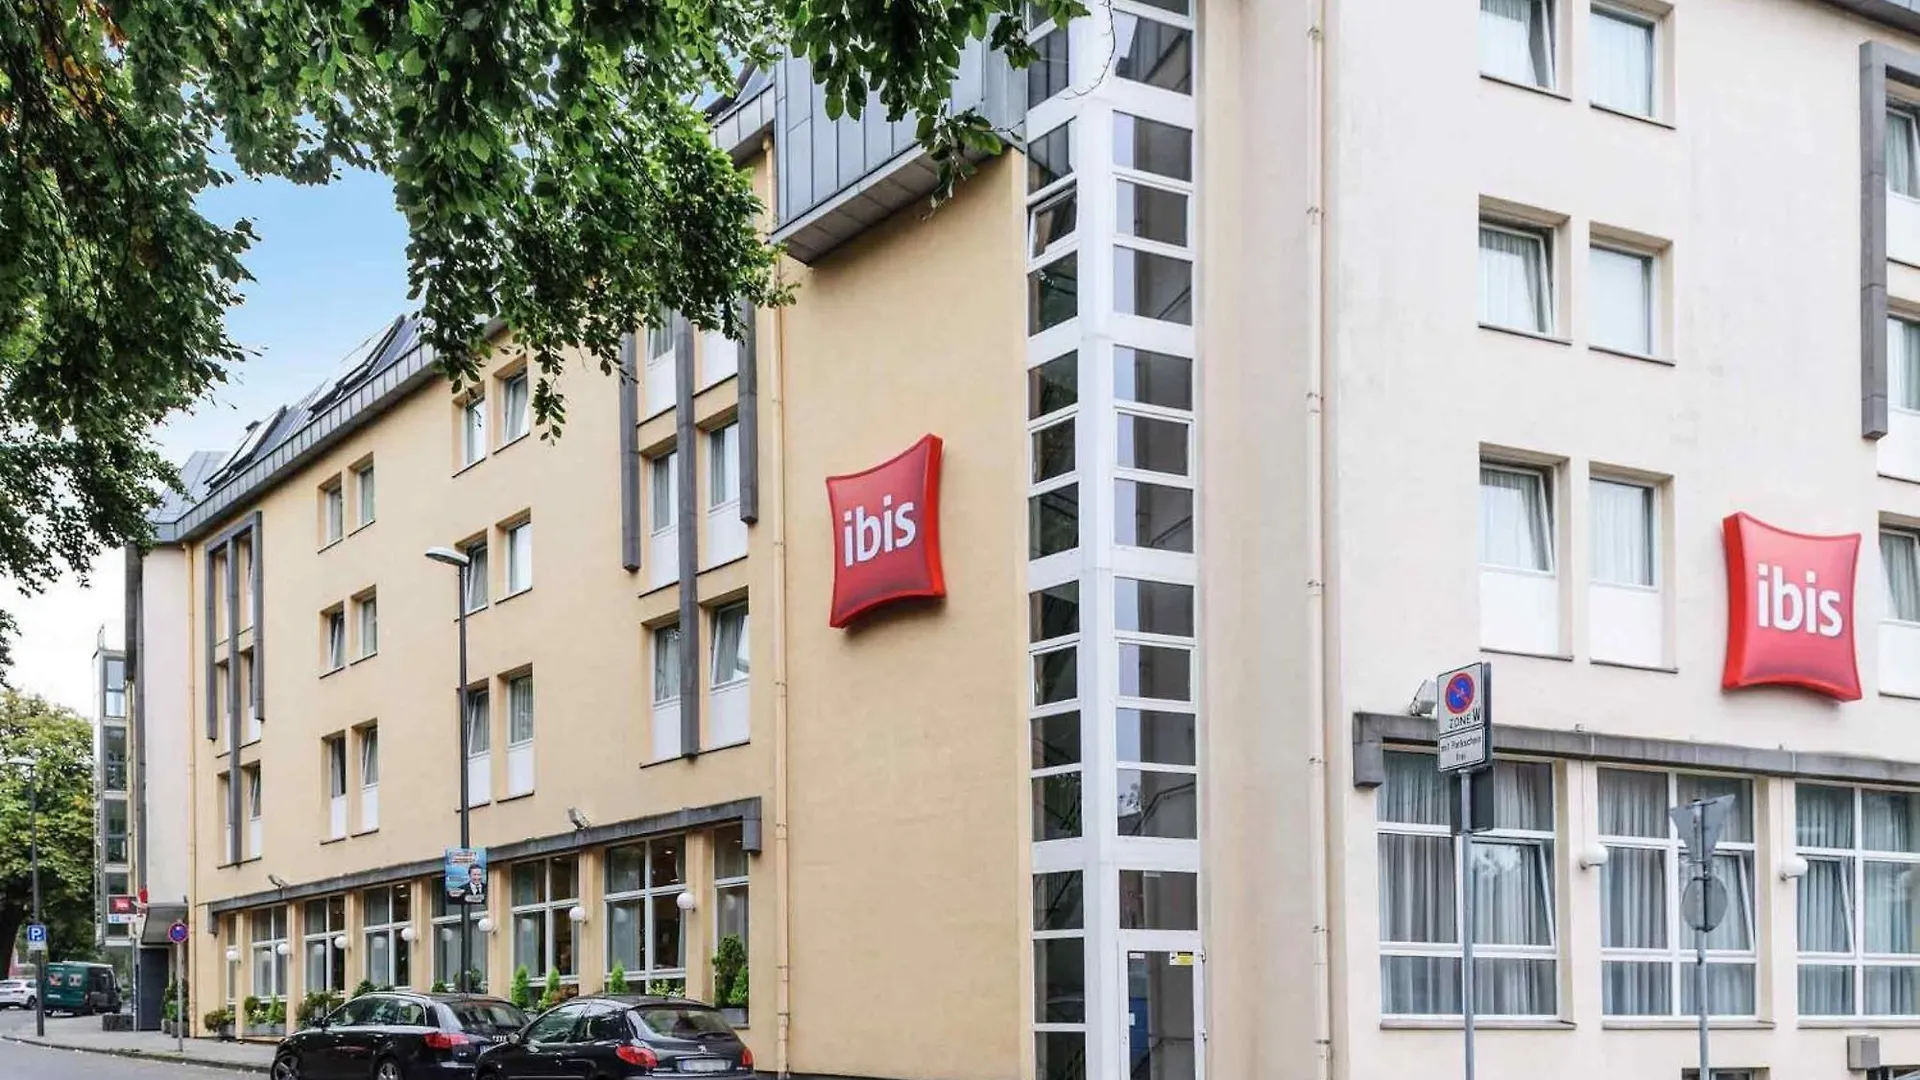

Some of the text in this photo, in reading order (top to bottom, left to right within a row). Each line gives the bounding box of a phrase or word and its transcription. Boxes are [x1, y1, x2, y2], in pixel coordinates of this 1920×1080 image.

[843, 495, 916, 567] ibis
[1757, 563, 1843, 637] ibis
[1449, 707, 1481, 729] ZONE W
[31, 927, 42, 940] P
